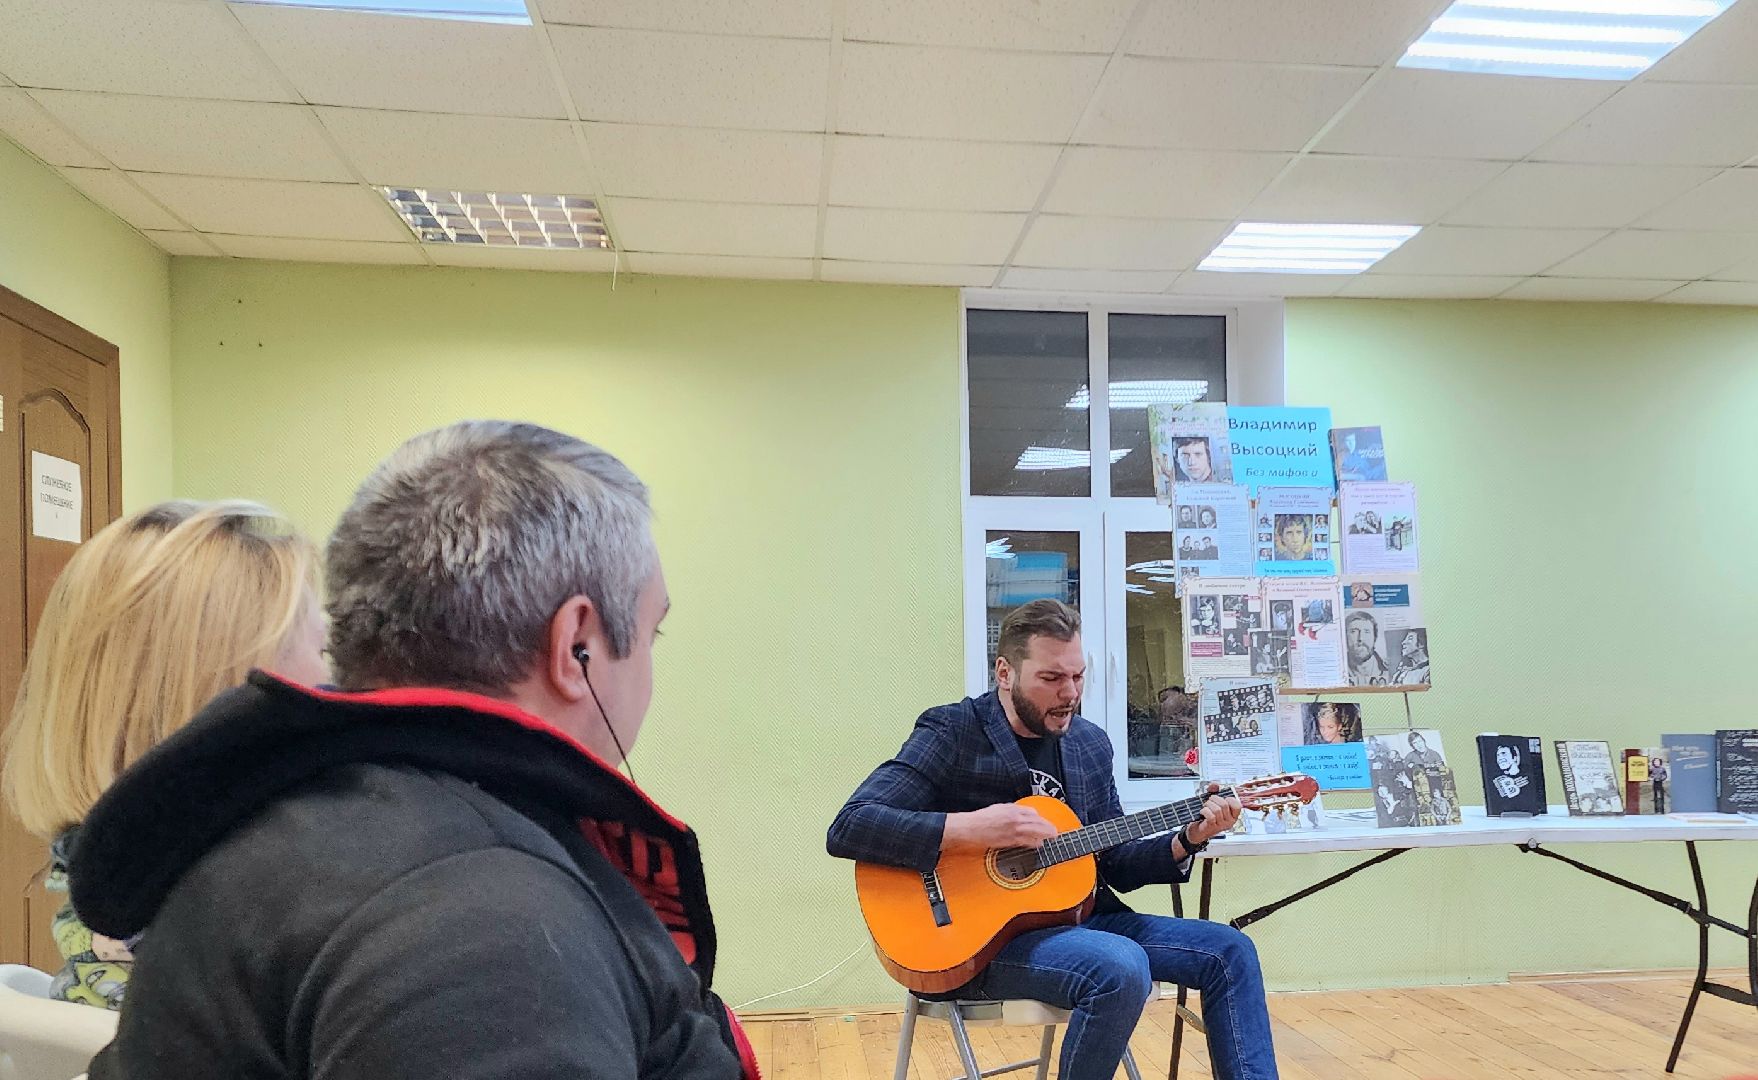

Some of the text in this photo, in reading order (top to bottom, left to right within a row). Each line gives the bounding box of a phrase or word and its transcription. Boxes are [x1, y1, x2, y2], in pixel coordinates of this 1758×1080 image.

[1228, 418, 1317, 433] Владимир
[1230, 442, 1318, 459] Высоцкий
[1245, 467, 1265, 477] Без
[1268, 468, 1308, 478] мифов
